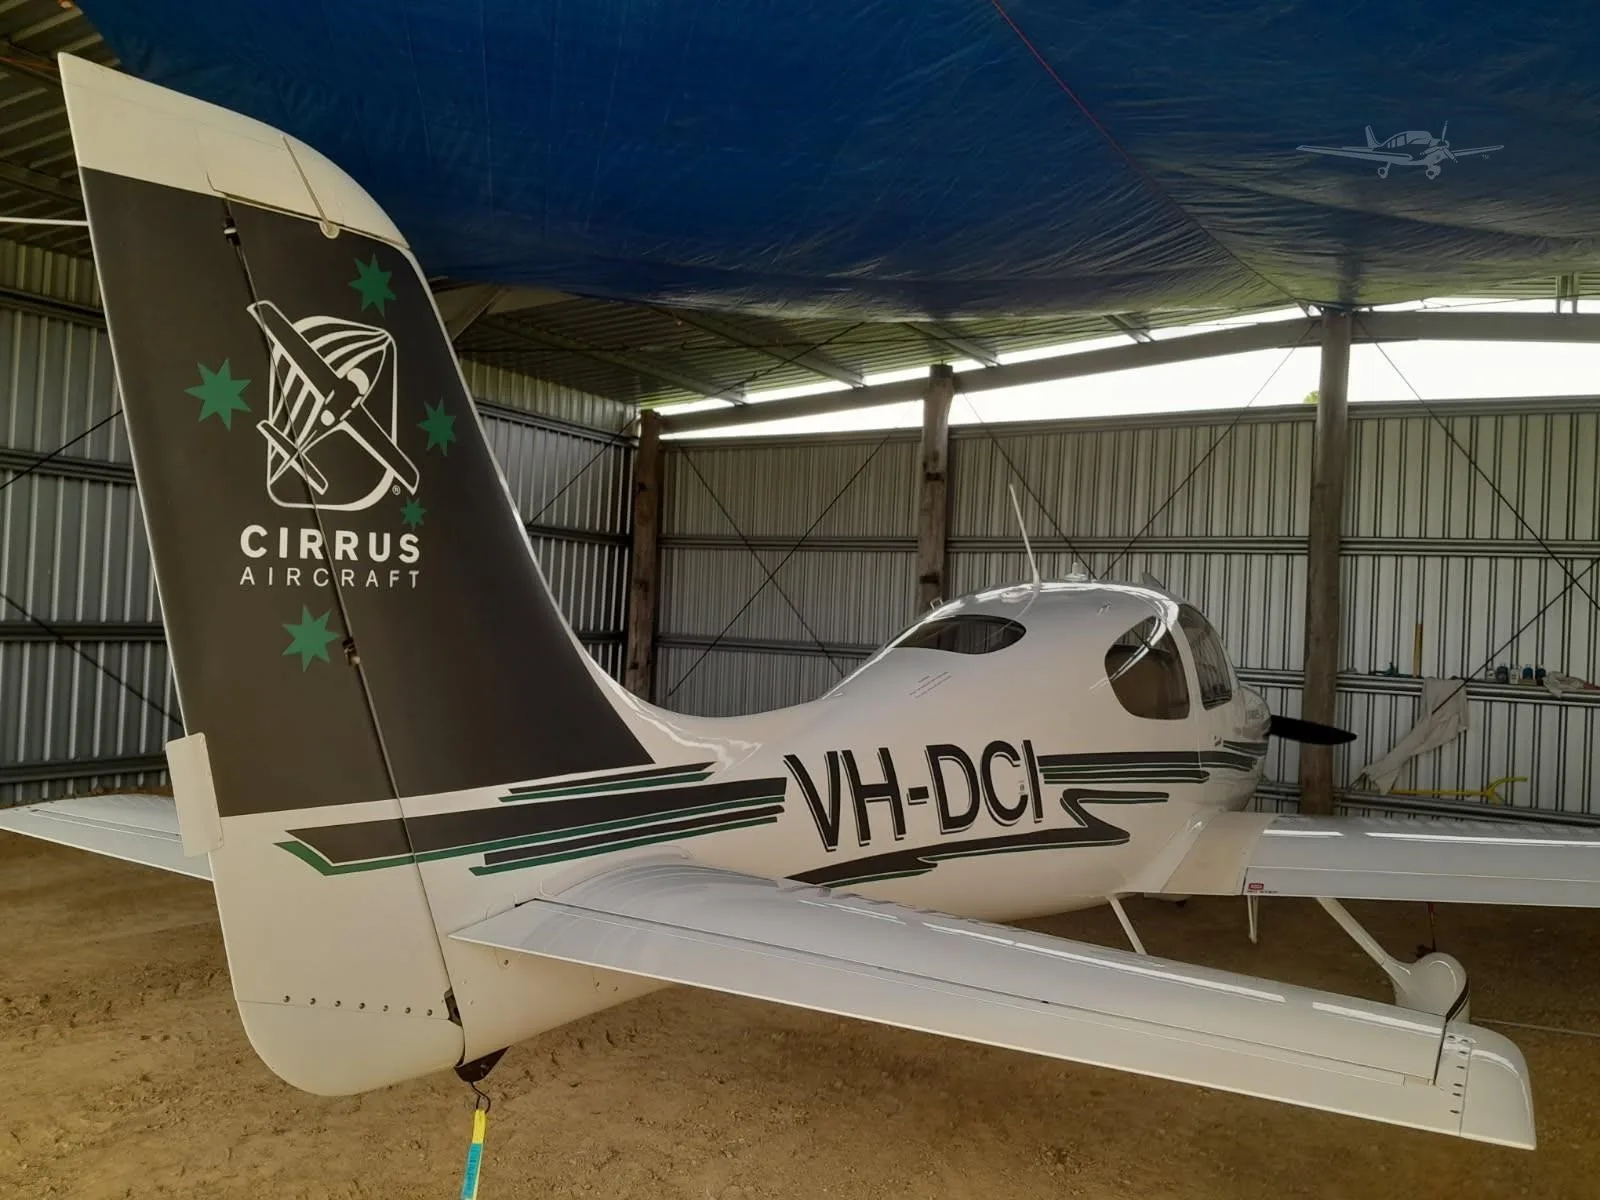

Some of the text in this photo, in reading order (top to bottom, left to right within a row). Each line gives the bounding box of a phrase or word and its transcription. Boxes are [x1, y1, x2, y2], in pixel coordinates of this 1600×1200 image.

[240, 524, 420, 563] CIRRUS
[240, 566, 420, 588] AIRCRAFT
[783, 739, 1044, 852] VH-DCI
